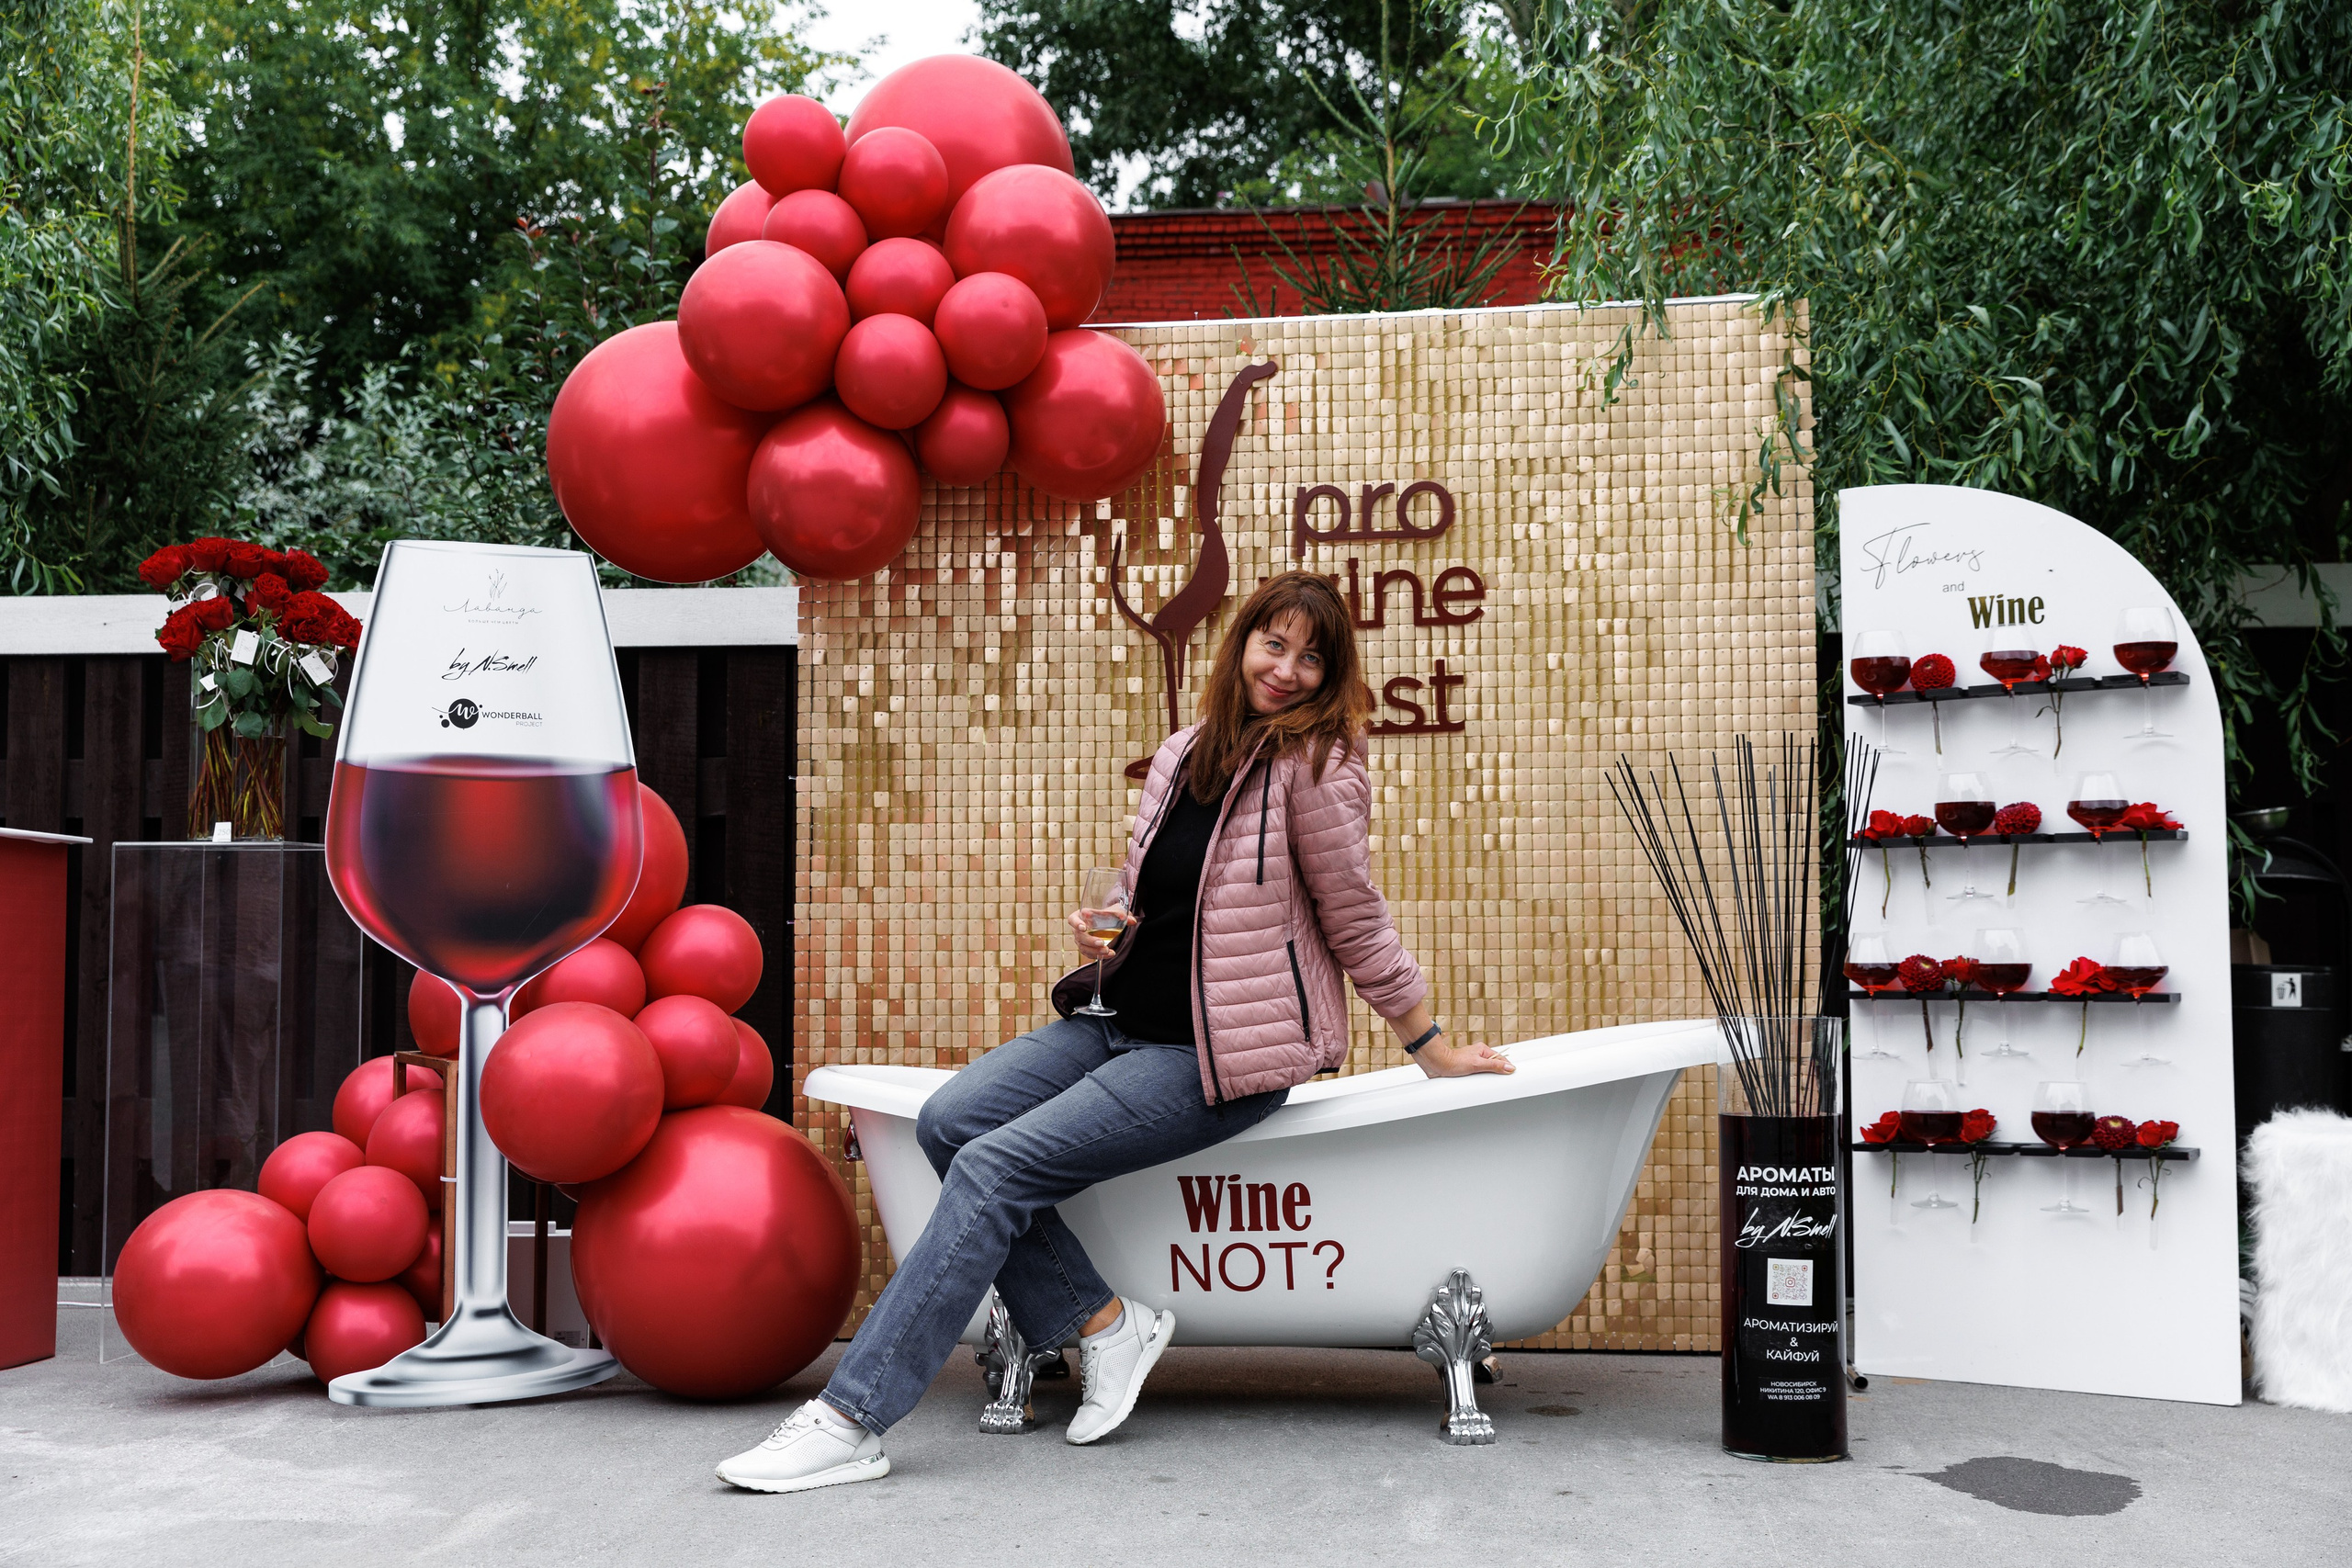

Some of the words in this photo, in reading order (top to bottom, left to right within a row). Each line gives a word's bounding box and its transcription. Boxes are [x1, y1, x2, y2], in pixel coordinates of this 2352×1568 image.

[1296, 480, 1454, 557] pro
[1860, 522, 1984, 590] Flowers
[1259, 558, 1486, 629] ine
[1942, 581, 1965, 592] and
[1967, 593, 2045, 629] Wine
[441, 648, 470, 681] by
[481, 711, 543, 720] WONDERBALL
[1736, 1166, 1836, 1183] АРОМАТЫ
[1177, 1174, 1312, 1233] Wine
[1736, 1185, 1758, 1196] ДЛЯ
[1760, 1187, 1799, 1198] ДОМА
[1801, 1187, 1810, 1197] И
[1812, 1186, 1837, 1196] АВТО
[1735, 1206, 1766, 1248] by
[1170, 1240, 1345, 1292] NOT?
[1743, 1317, 1838, 1333] АРОМАТИЗИРУЙ
[1766, 1348, 1820, 1362] КАЙФУЙ
[1790, 1337, 1799, 1348] &
